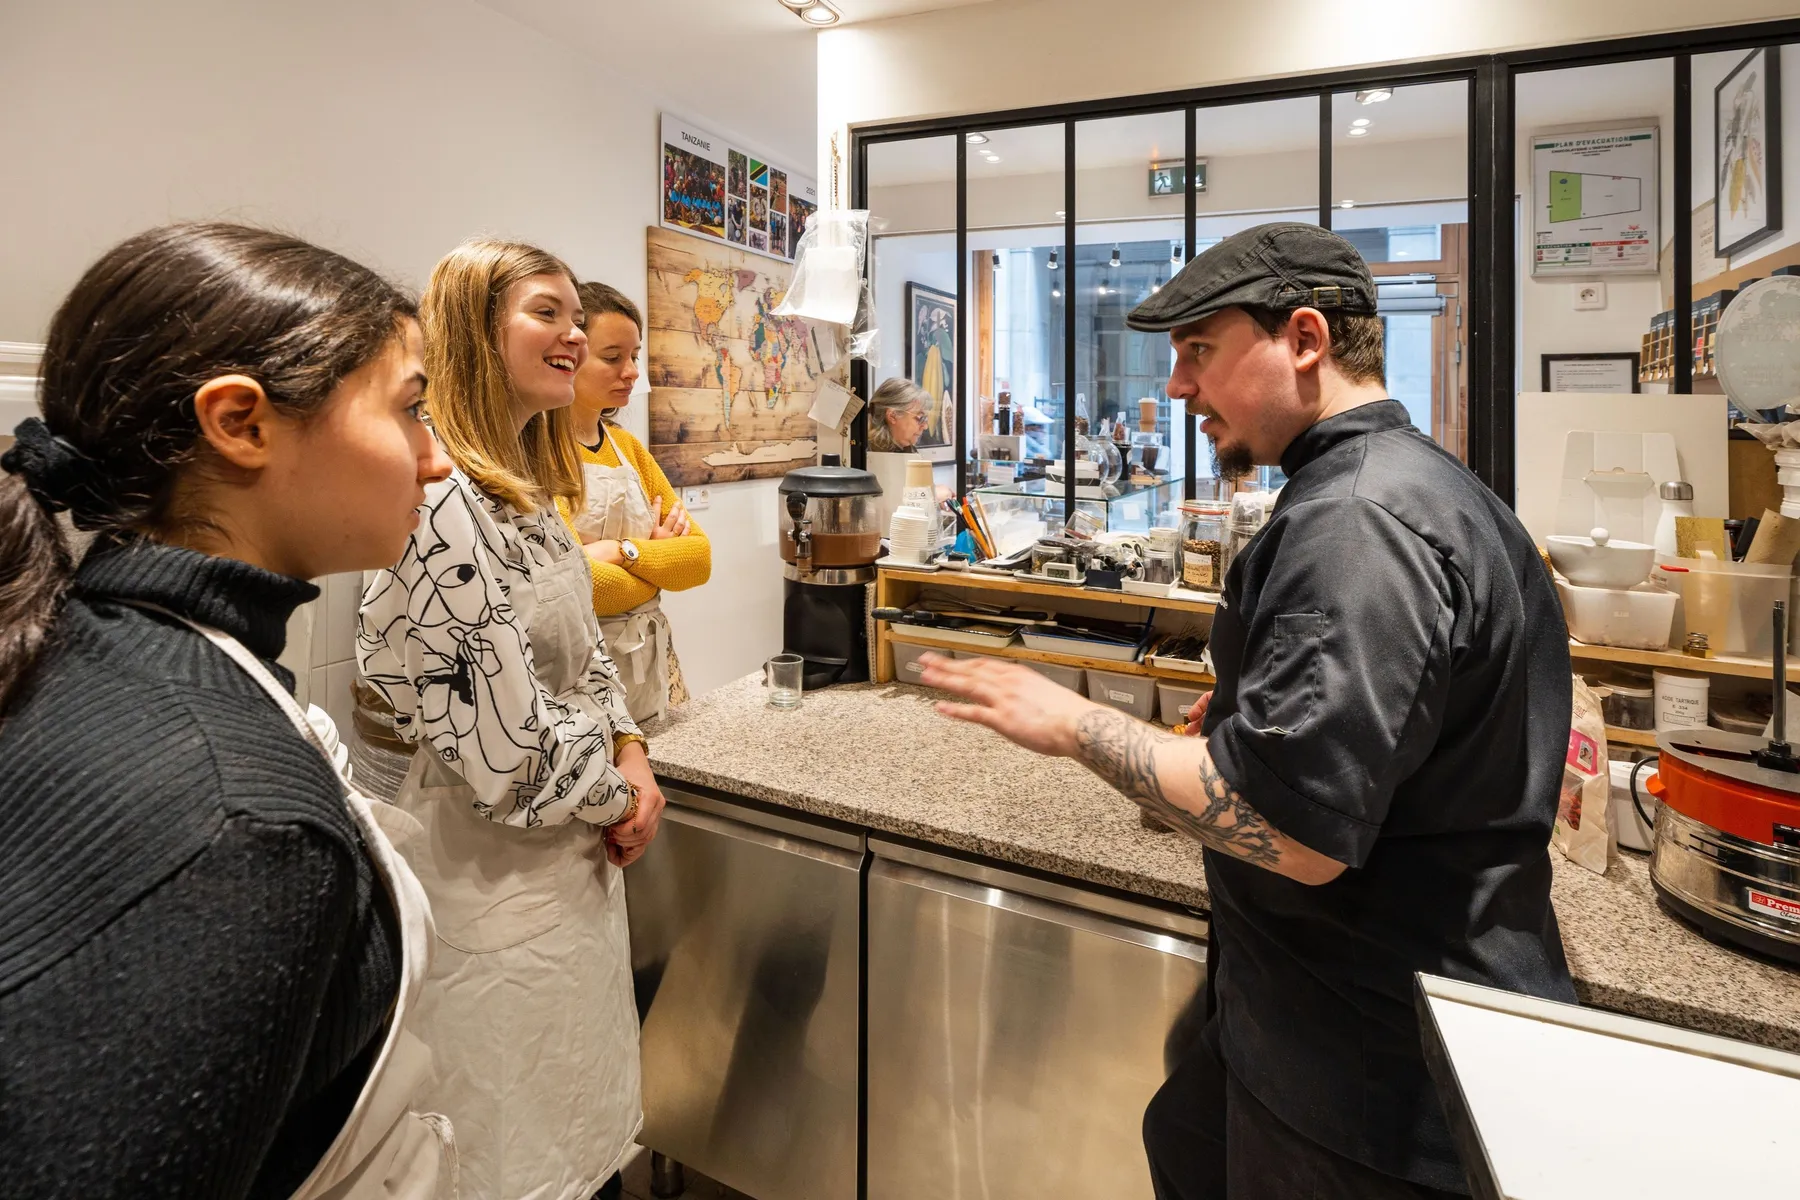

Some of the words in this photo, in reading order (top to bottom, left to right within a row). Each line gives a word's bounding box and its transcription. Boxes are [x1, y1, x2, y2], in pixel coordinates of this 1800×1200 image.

[681, 131, 711, 151] TANZANIE
[1576, 136, 1630, 146] D'EVACUATION
[805, 186, 816, 196] 2021
